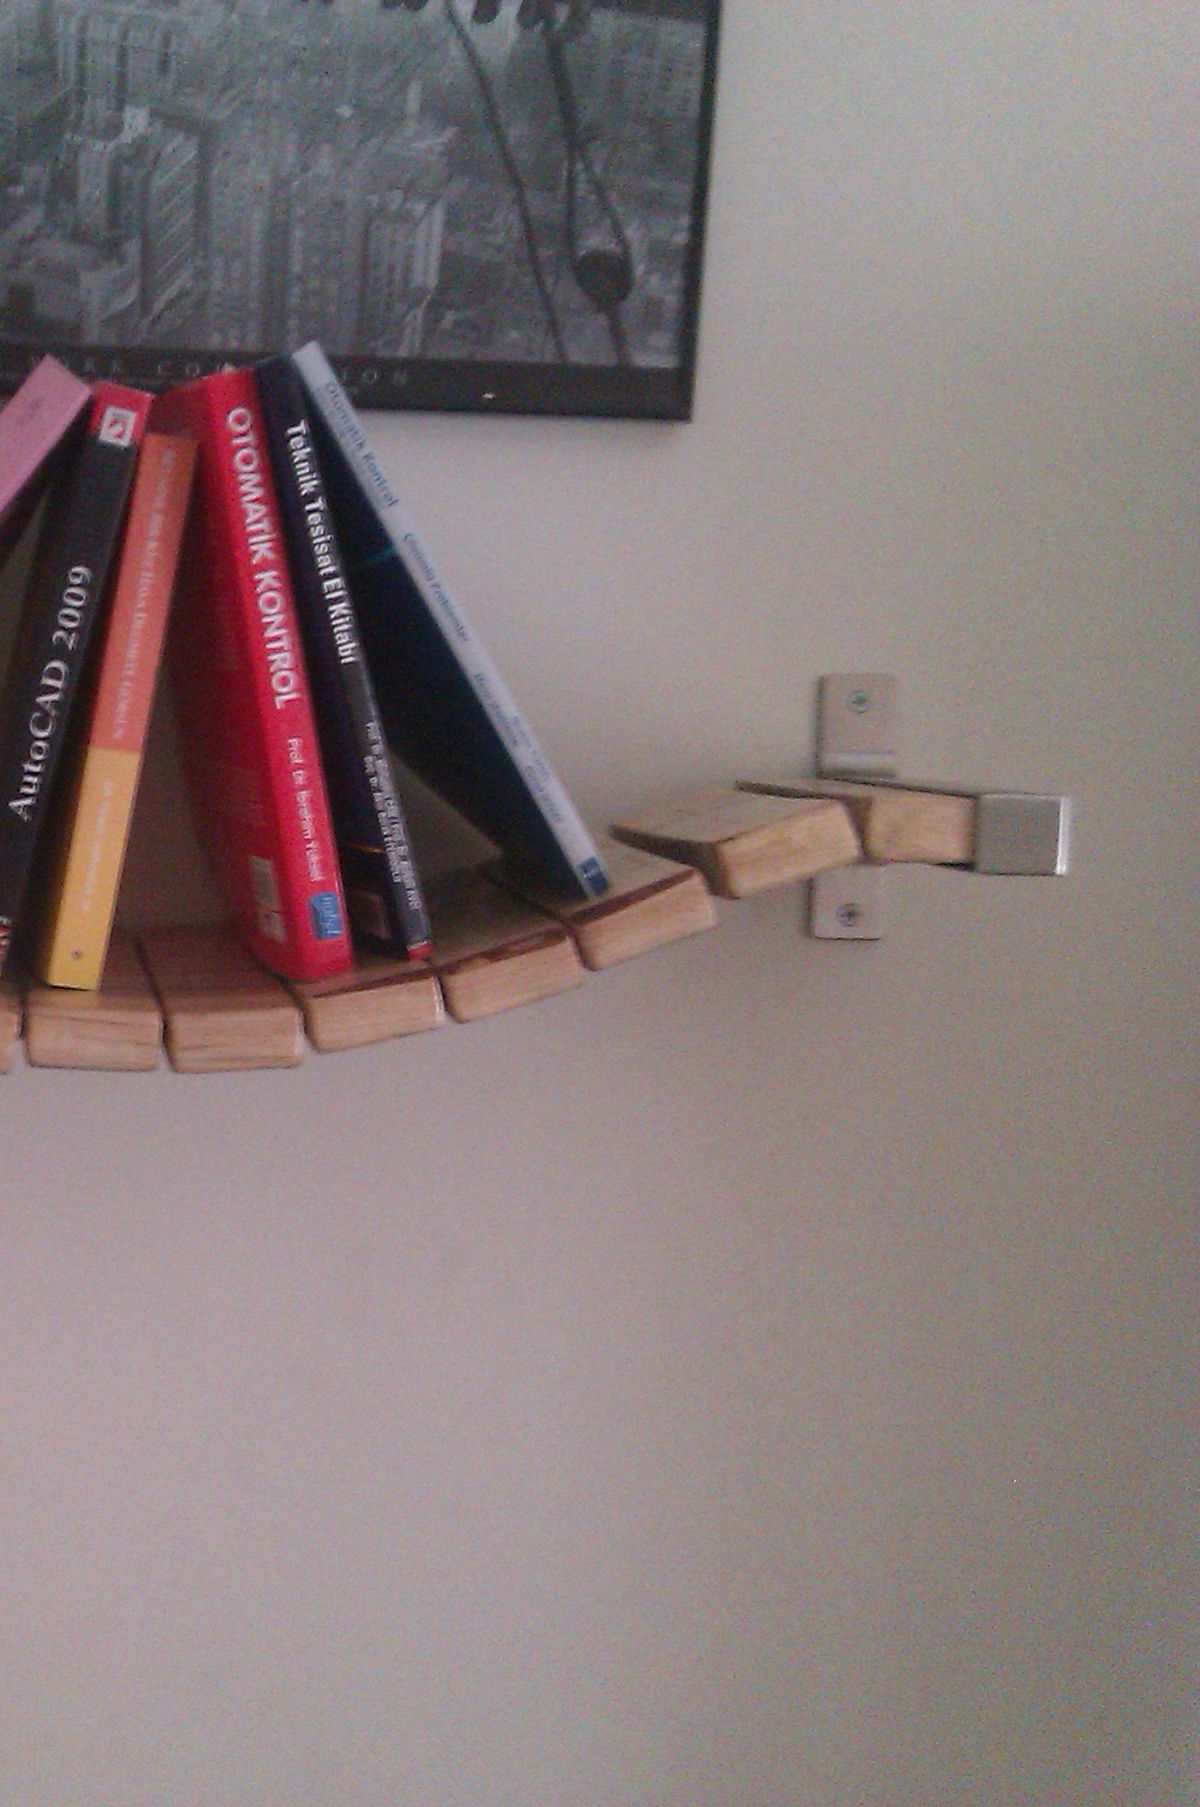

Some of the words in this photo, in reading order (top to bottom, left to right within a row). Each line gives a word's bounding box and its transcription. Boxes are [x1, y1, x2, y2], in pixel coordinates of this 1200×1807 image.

[286, 419, 320, 495] Teknik
[305, 495, 338, 576] Tesisat
[7, 659, 70, 822] AutoCAD
[51, 565, 93, 651] 2009
[252, 570, 302, 709] KONTROL
